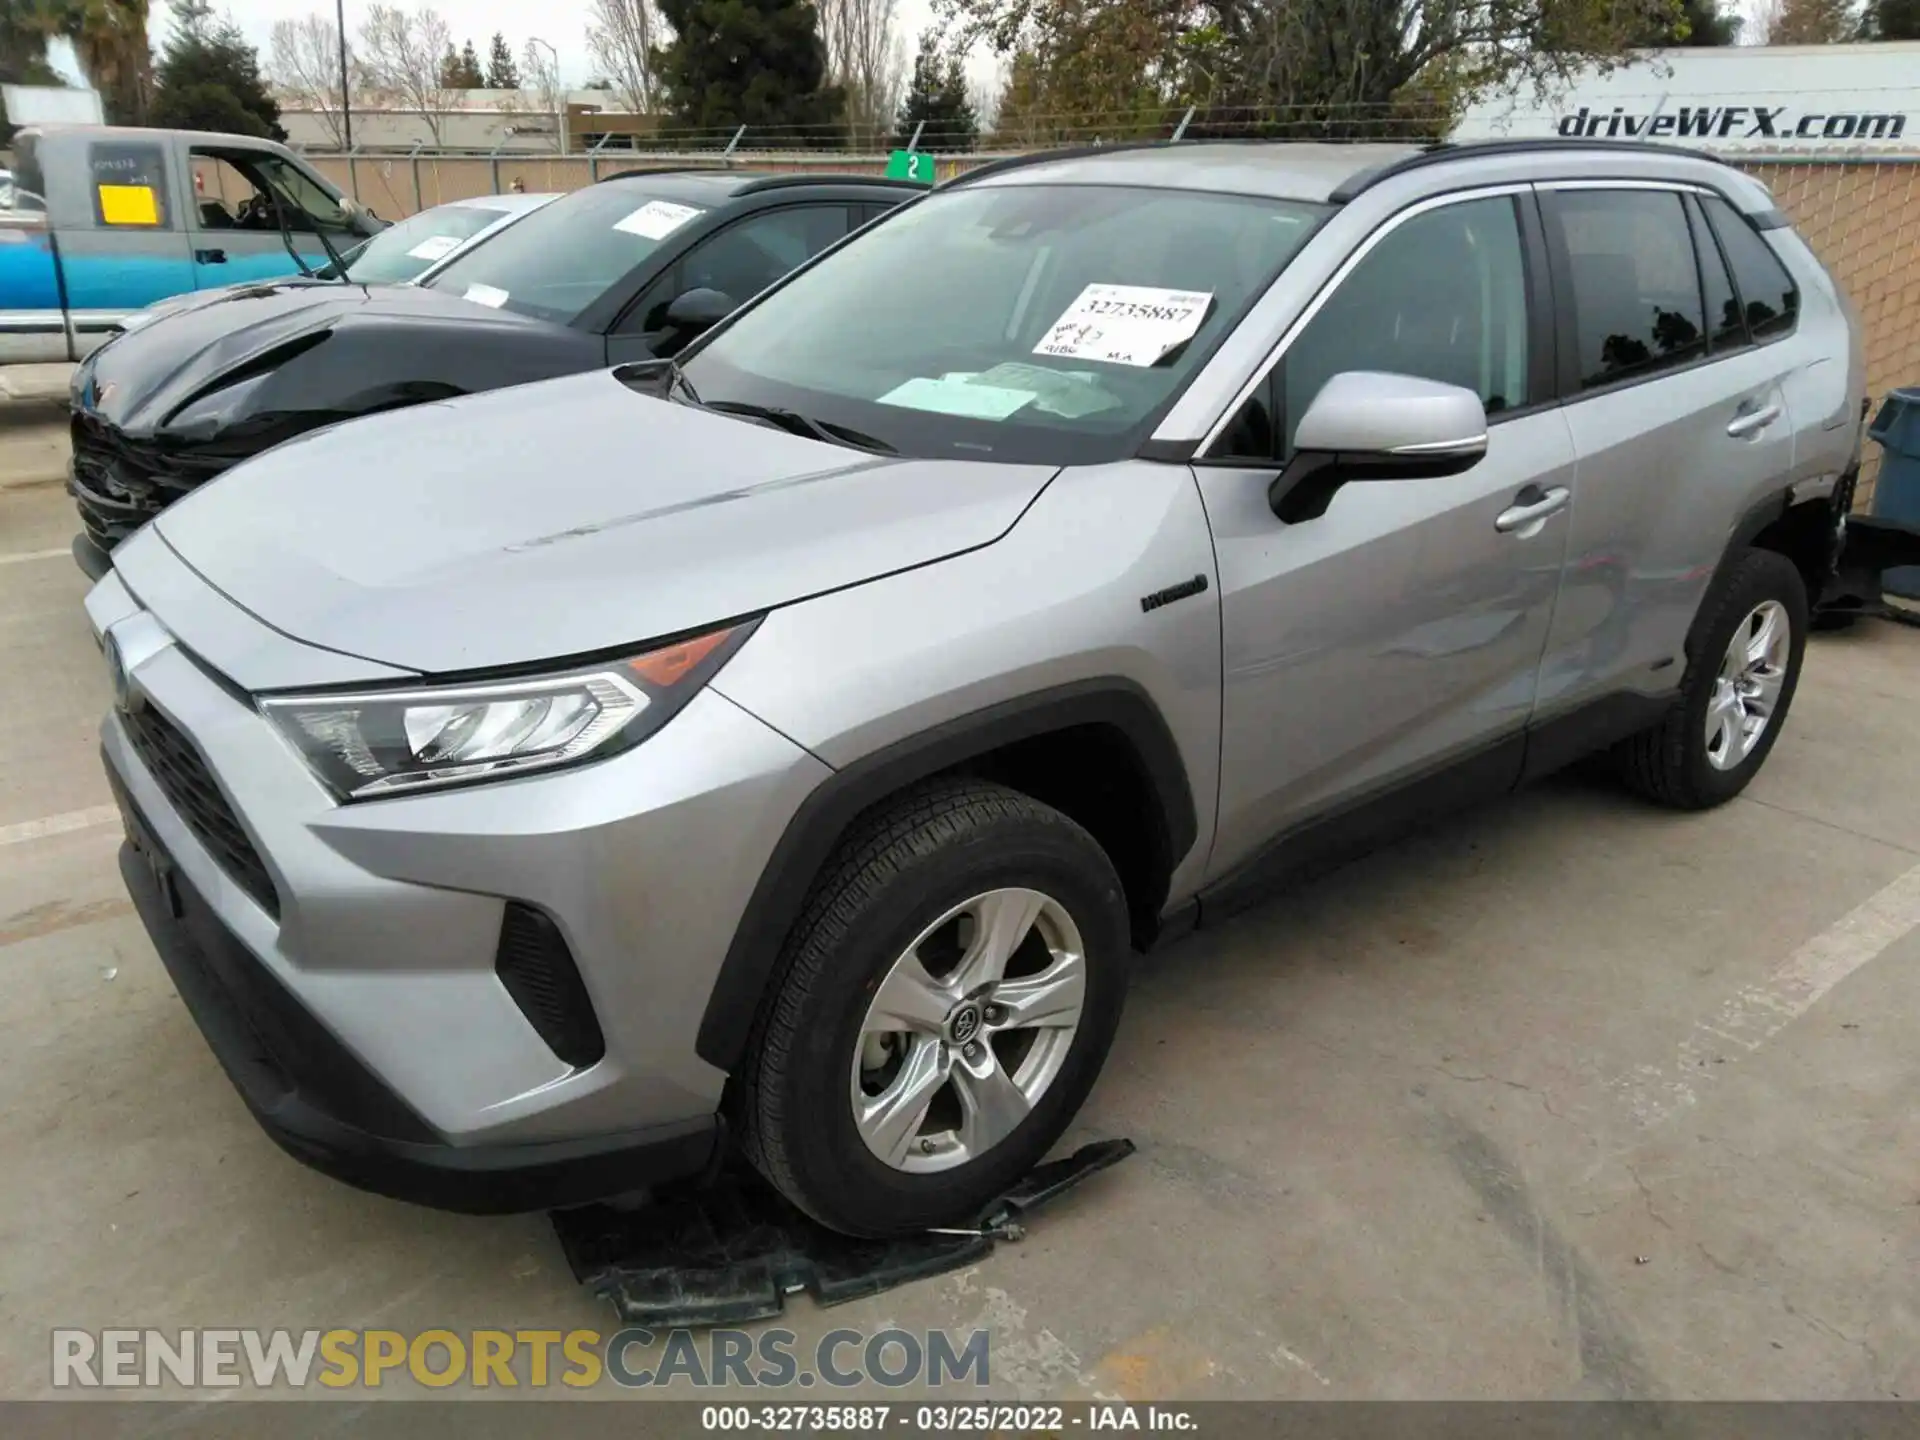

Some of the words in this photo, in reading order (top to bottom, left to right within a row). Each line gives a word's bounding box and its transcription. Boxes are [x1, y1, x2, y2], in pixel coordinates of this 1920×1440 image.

[1557, 107, 1907, 138] driveWFX.com
[907, 155, 919, 179] 2
[1081, 299, 1193, 322] 32735887
